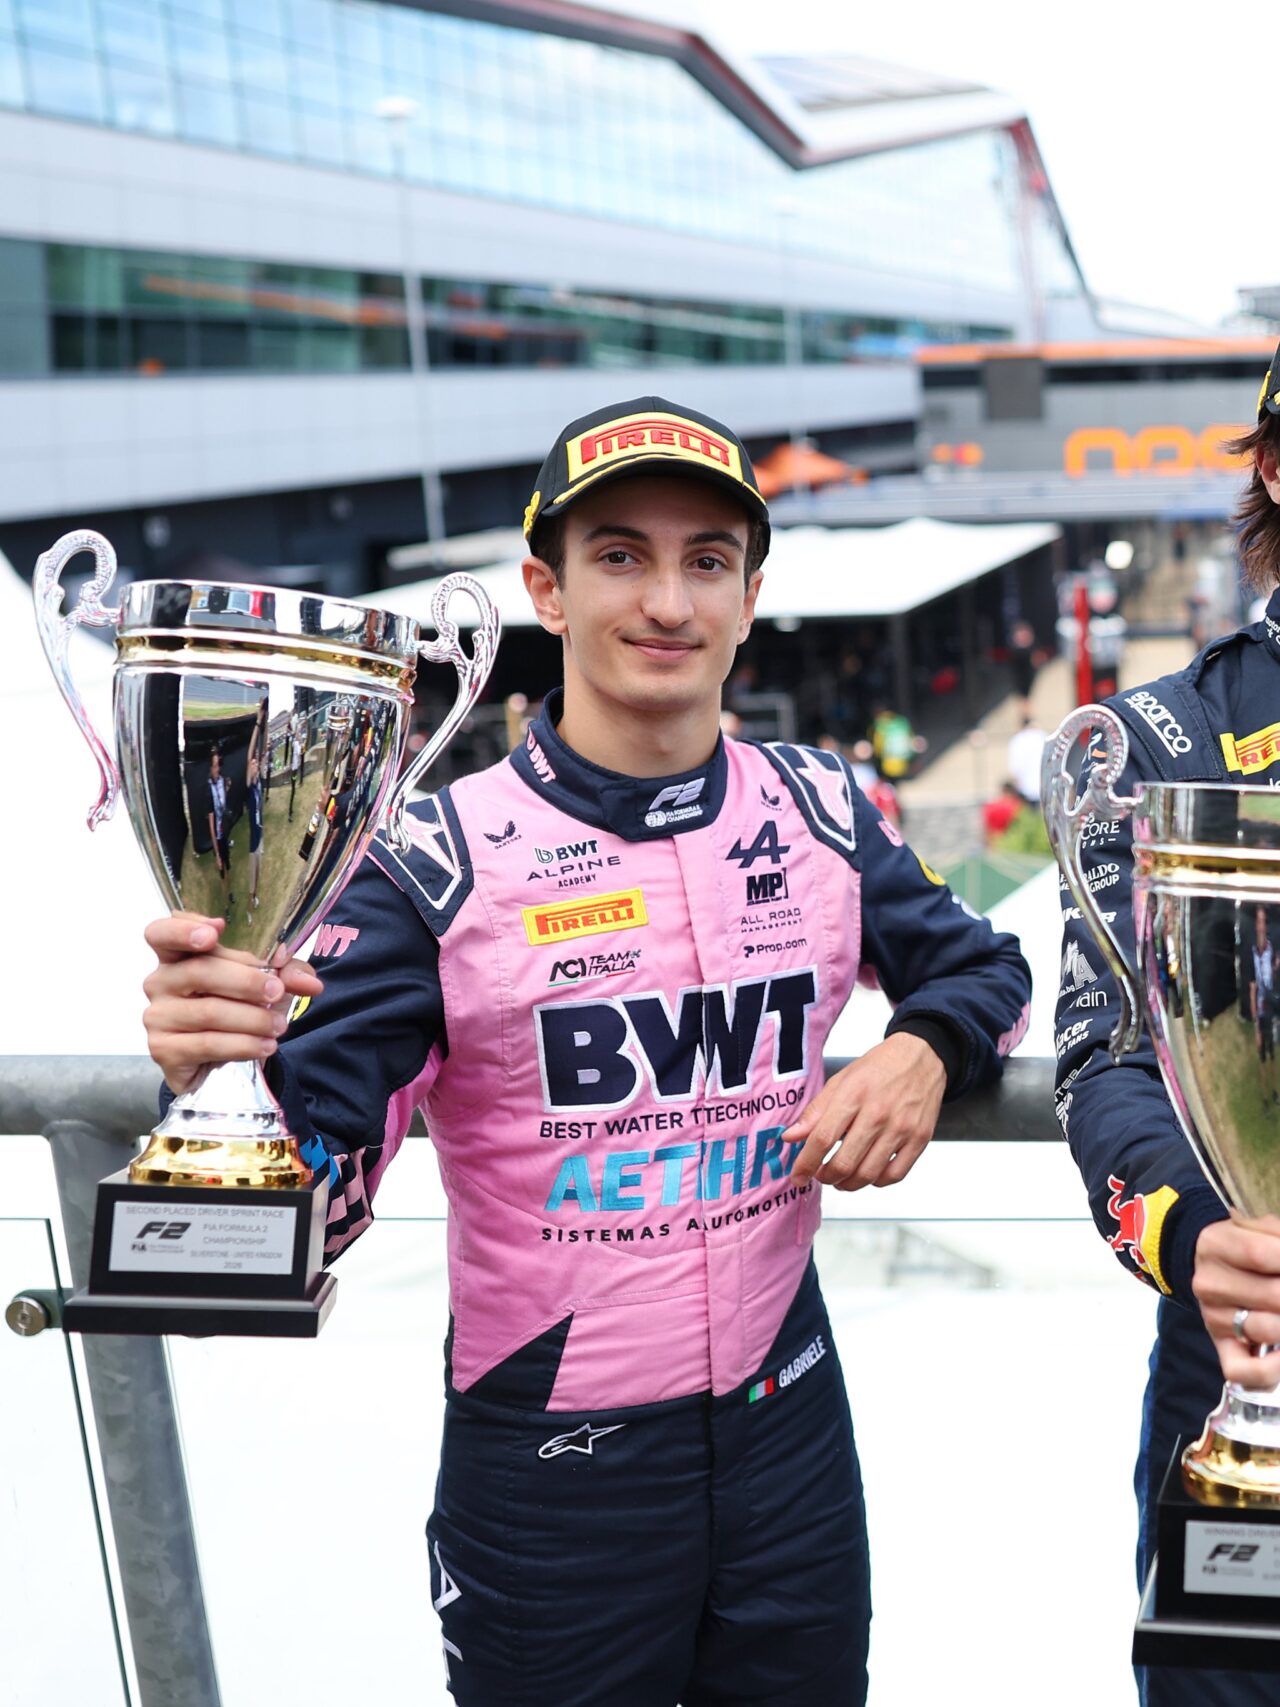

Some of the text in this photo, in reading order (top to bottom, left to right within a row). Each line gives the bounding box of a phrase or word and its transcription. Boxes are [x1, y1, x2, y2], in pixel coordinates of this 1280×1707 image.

[580, 420, 730, 467] PIRELLI
[1125, 690, 1192, 759] sparco
[529, 747, 557, 784] BWT
[649, 777, 706, 811] F2
[556, 840, 598, 862] BWT
[527, 855, 622, 881] ALPINE
[558, 873, 597, 889] ACADEMY
[1090, 874, 1120, 893] GROUP
[535, 897, 635, 936] PIRELLI
[741, 907, 801, 925] ALL ROAD
[314, 924, 360, 957] WT
[756, 938, 808, 954] Prop.com
[588, 960, 636, 977] ITALIA
[590, 950, 630, 965] TEAM
[533, 964, 819, 1113] BWT
[540, 1121, 597, 1139] BEST
[605, 1112, 683, 1137] WATER
[164, 1206, 196, 1216] PLACED
[198, 1207, 229, 1217] DRIVER
[231, 1208, 260, 1218] SPRINT
[261, 1209, 285, 1219] RACE
[135, 1221, 192, 1240] F2
[542, 1223, 670, 1242] SISTEMAS
[778, 1335, 826, 1388] GABRIELE
[1206, 1543, 1261, 1562] F2
